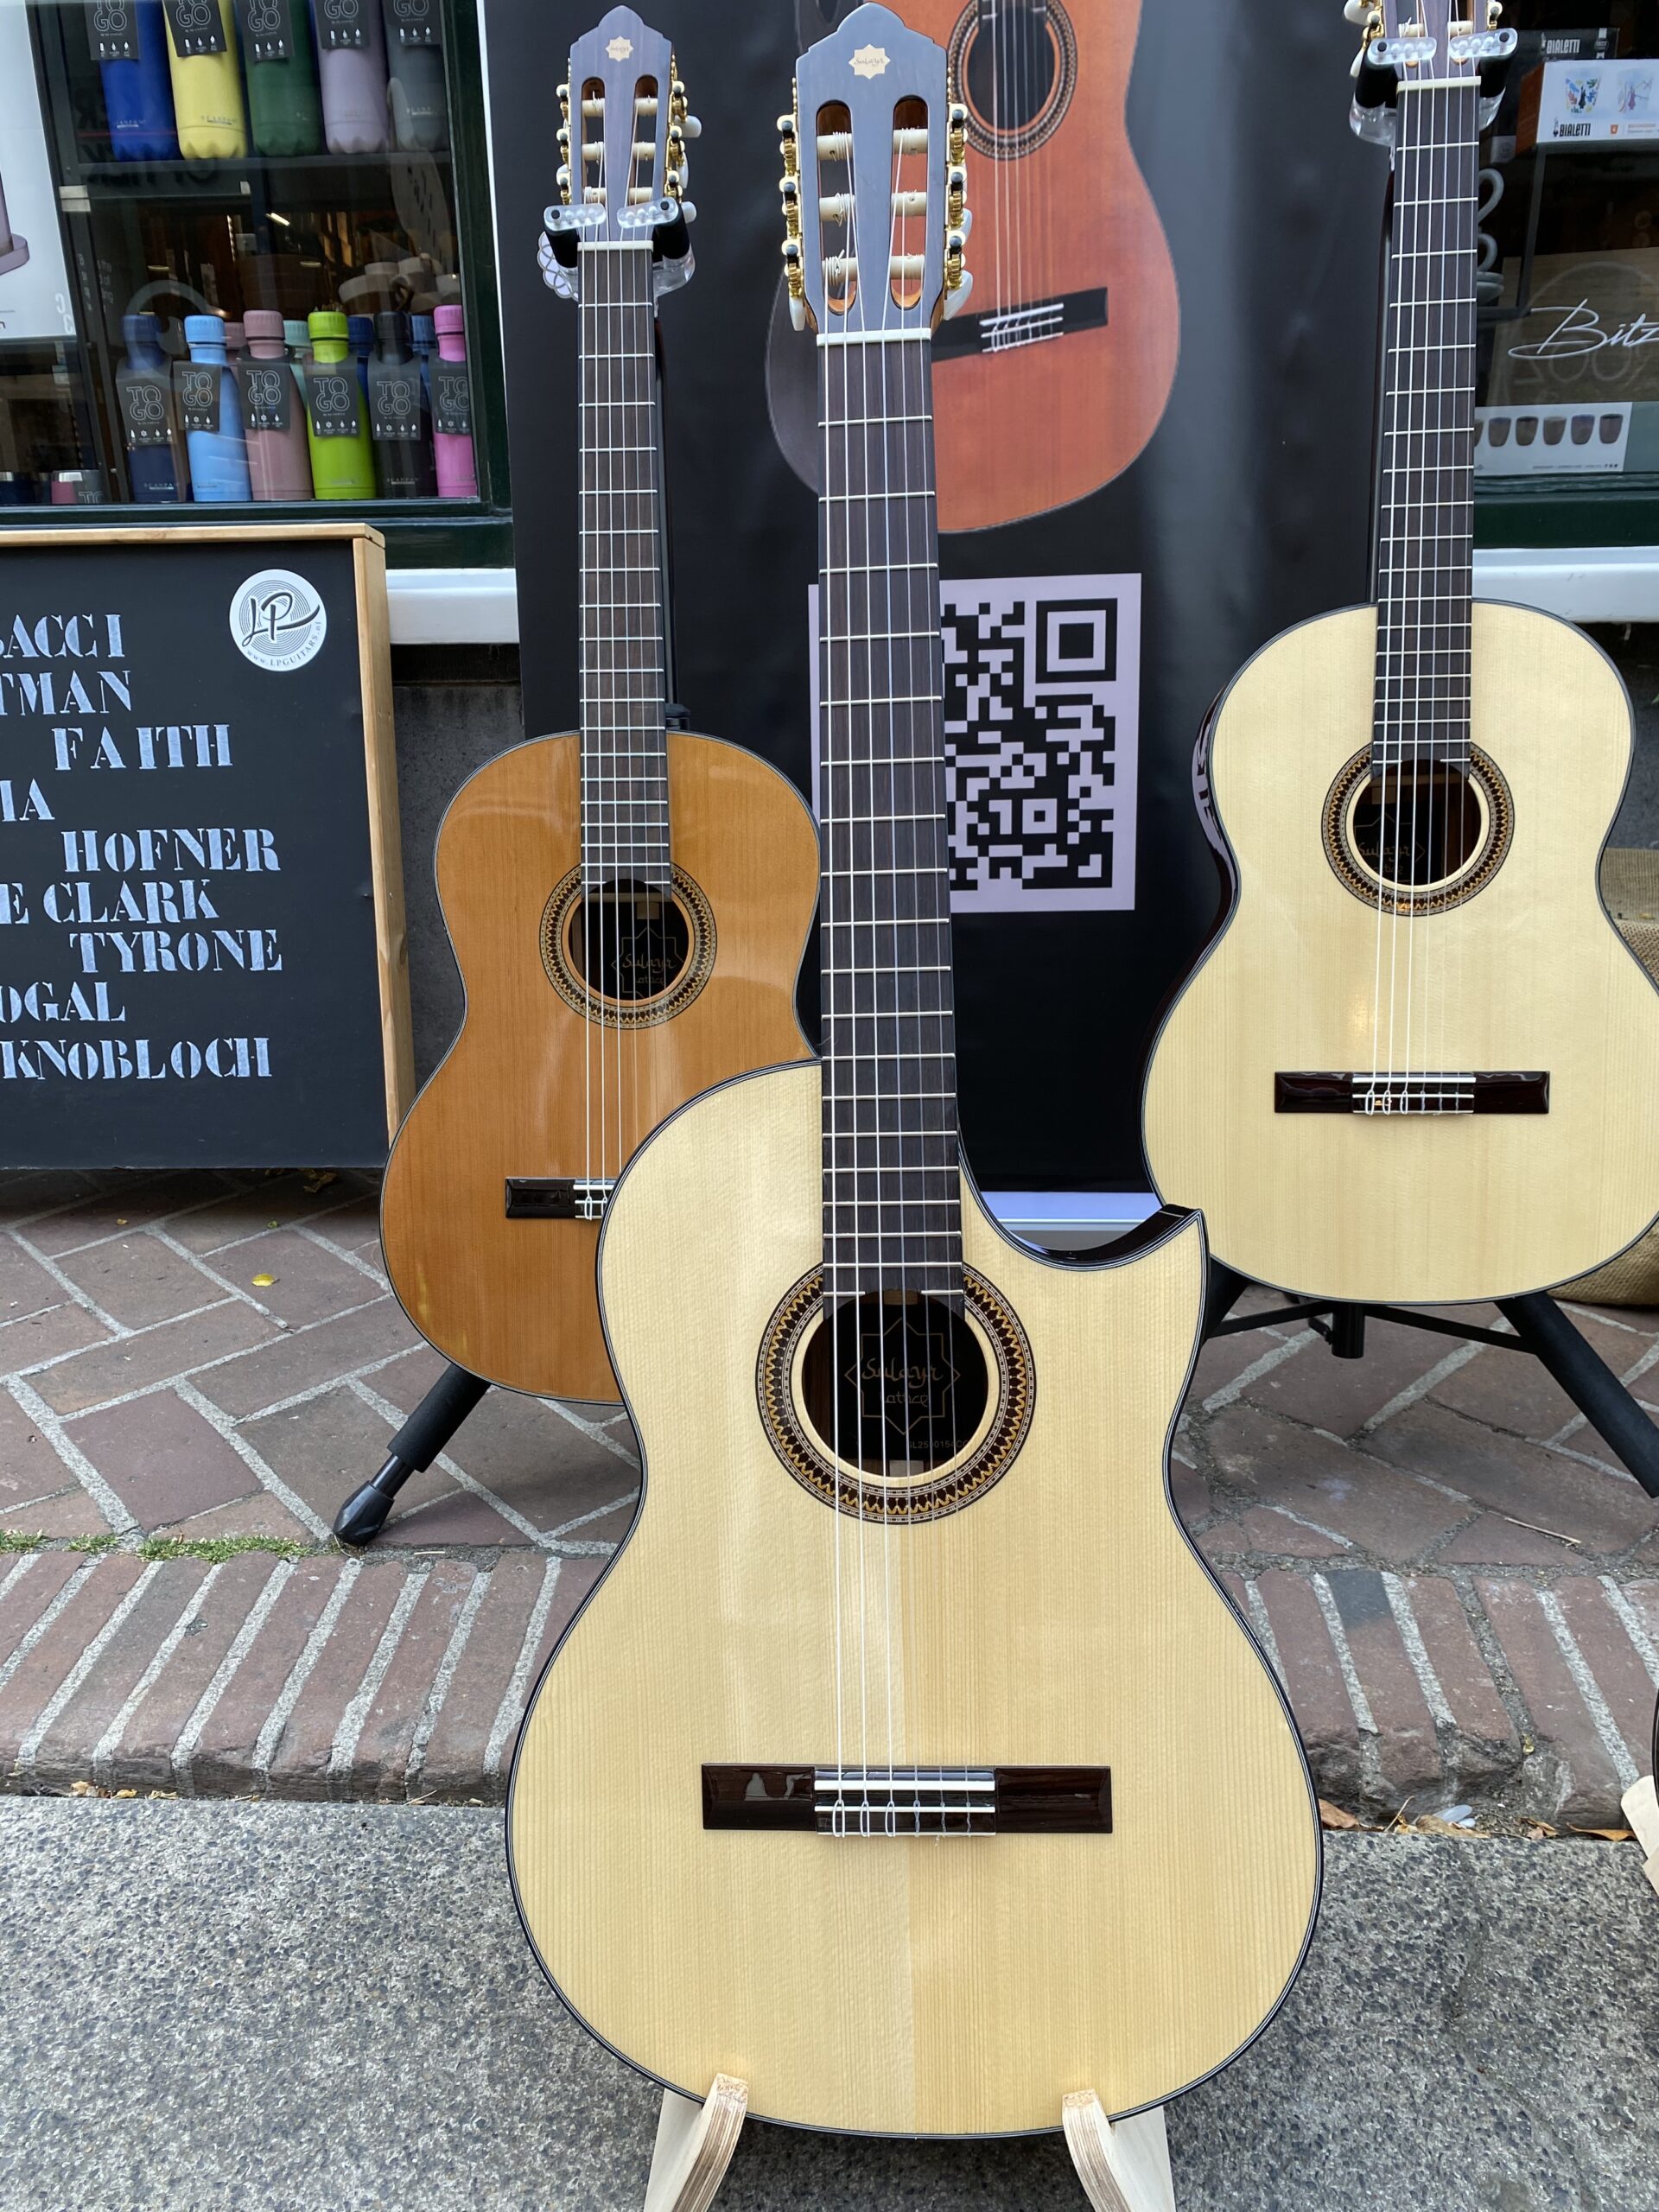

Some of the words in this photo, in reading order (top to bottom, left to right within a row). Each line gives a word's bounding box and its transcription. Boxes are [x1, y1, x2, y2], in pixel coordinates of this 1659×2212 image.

[175, 3, 212, 28] GO
[323, 0, 359, 19] GO
[393, 0, 429, 16] GO
[93, 10, 128, 32] GO
[247, 7, 281, 32] GO
[181, 371, 213, 388] TO
[246, 369, 280, 387] TO
[313, 376, 348, 393] TO
[438, 376, 467, 394] TO
[126, 385, 162, 402] TO
[182, 387, 213, 408] GO
[247, 385, 282, 405] GO
[377, 380, 410, 397] TO
[130, 401, 164, 421] GO
[315, 391, 350, 412] GO
[378, 396, 411, 416] GO
[439, 391, 469, 411] GO
[0, 614, 125, 658] ACCI
[246, 621, 321, 667] www.LPGUITARS.nl
[52, 724, 233, 771] FAITH
[61, 828, 282, 874] HOFNER
[0, 882, 29, 925] E
[43, 879, 219, 925] CLARK
[69, 929, 283, 973] TYRONE
[0, 1038, 272, 1081] KNOBLOCH
